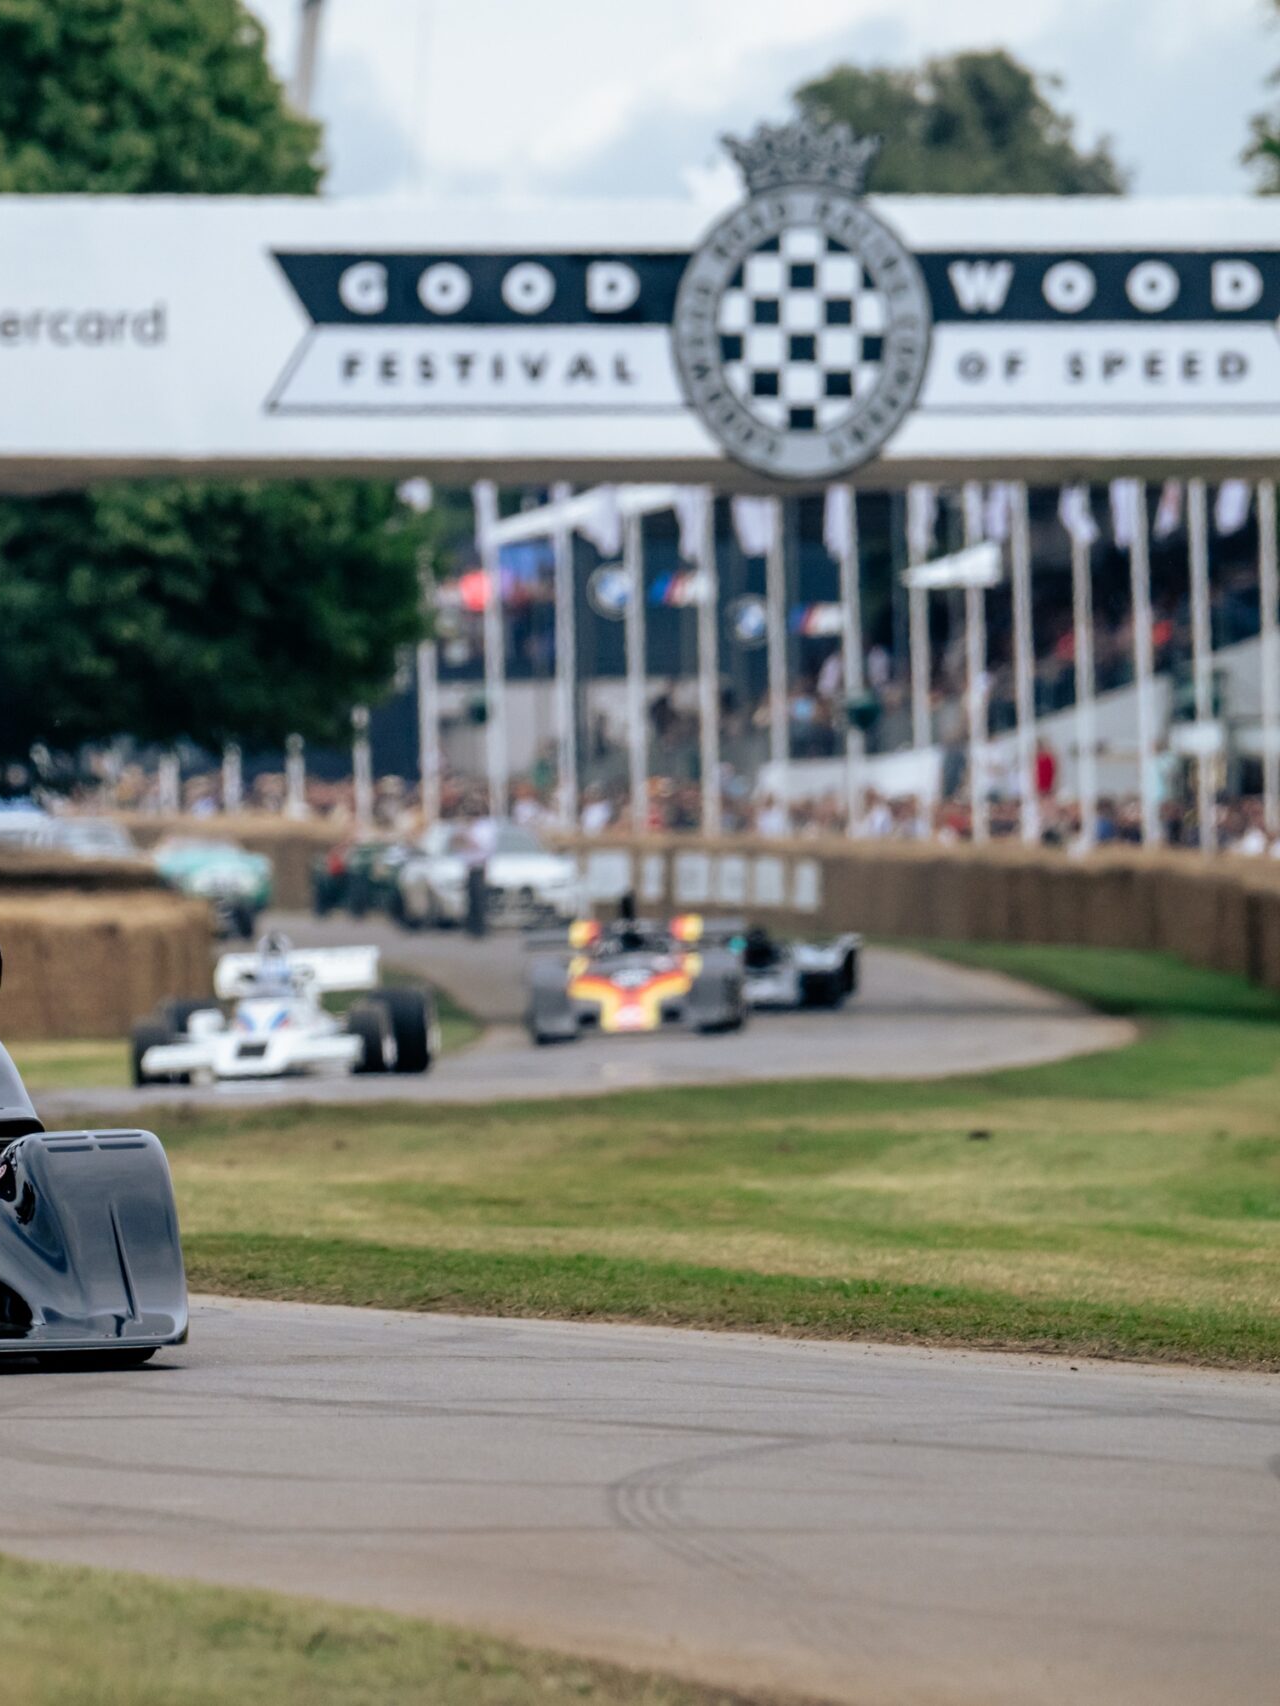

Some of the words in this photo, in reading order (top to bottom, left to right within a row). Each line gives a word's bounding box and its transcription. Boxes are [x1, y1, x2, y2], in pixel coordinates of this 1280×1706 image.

[338, 260, 641, 315] GOOD
[947, 260, 1264, 314] WOOD
[340, 352, 635, 383] FESTIVAL
[957, 352, 1025, 382] OF
[1068, 351, 1250, 382] SPEED
